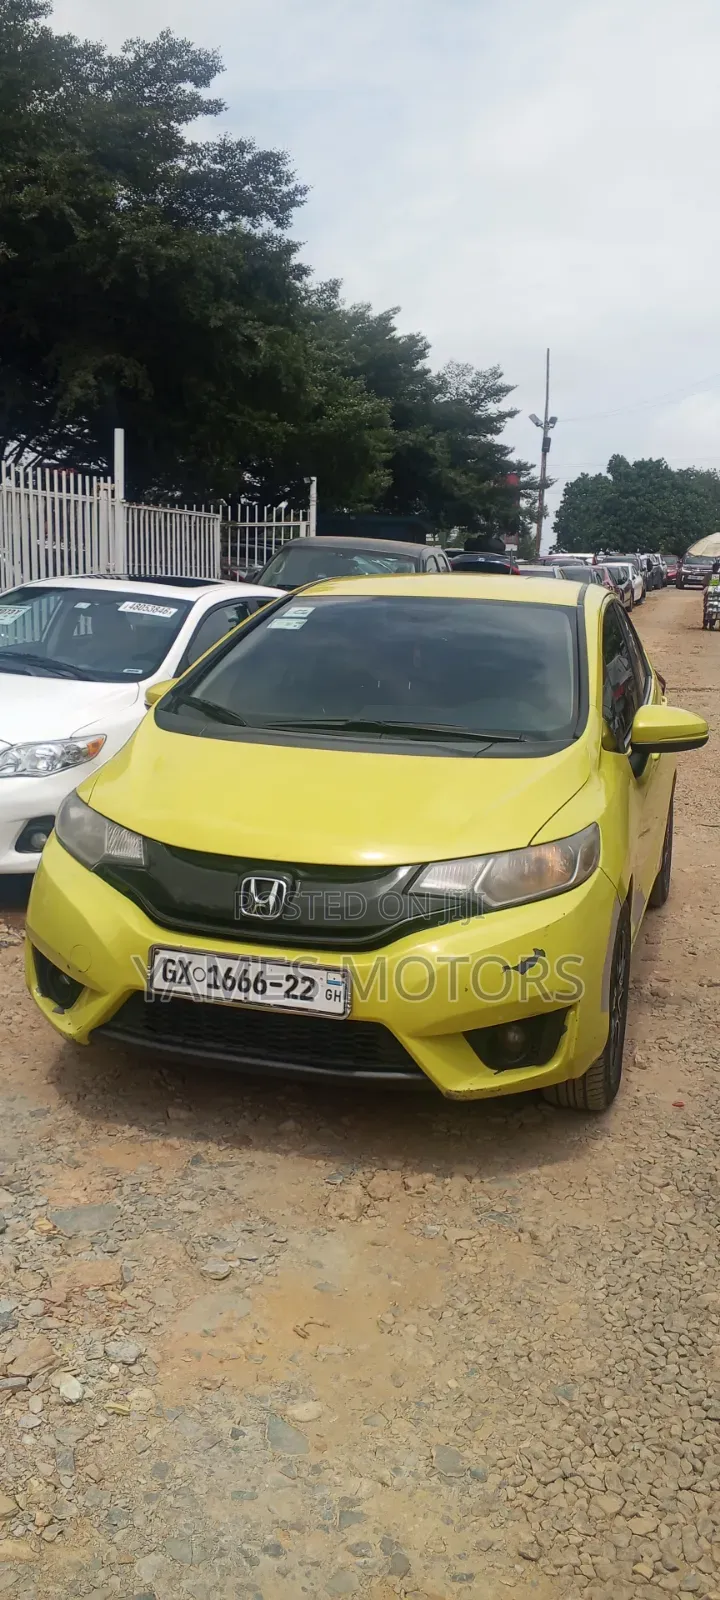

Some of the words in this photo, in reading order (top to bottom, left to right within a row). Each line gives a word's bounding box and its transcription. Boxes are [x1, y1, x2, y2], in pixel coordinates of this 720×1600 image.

[162, 958, 193, 986] GX
[207, 964, 316, 1002] 1666-22
[325, 988, 342, 1003] GH
